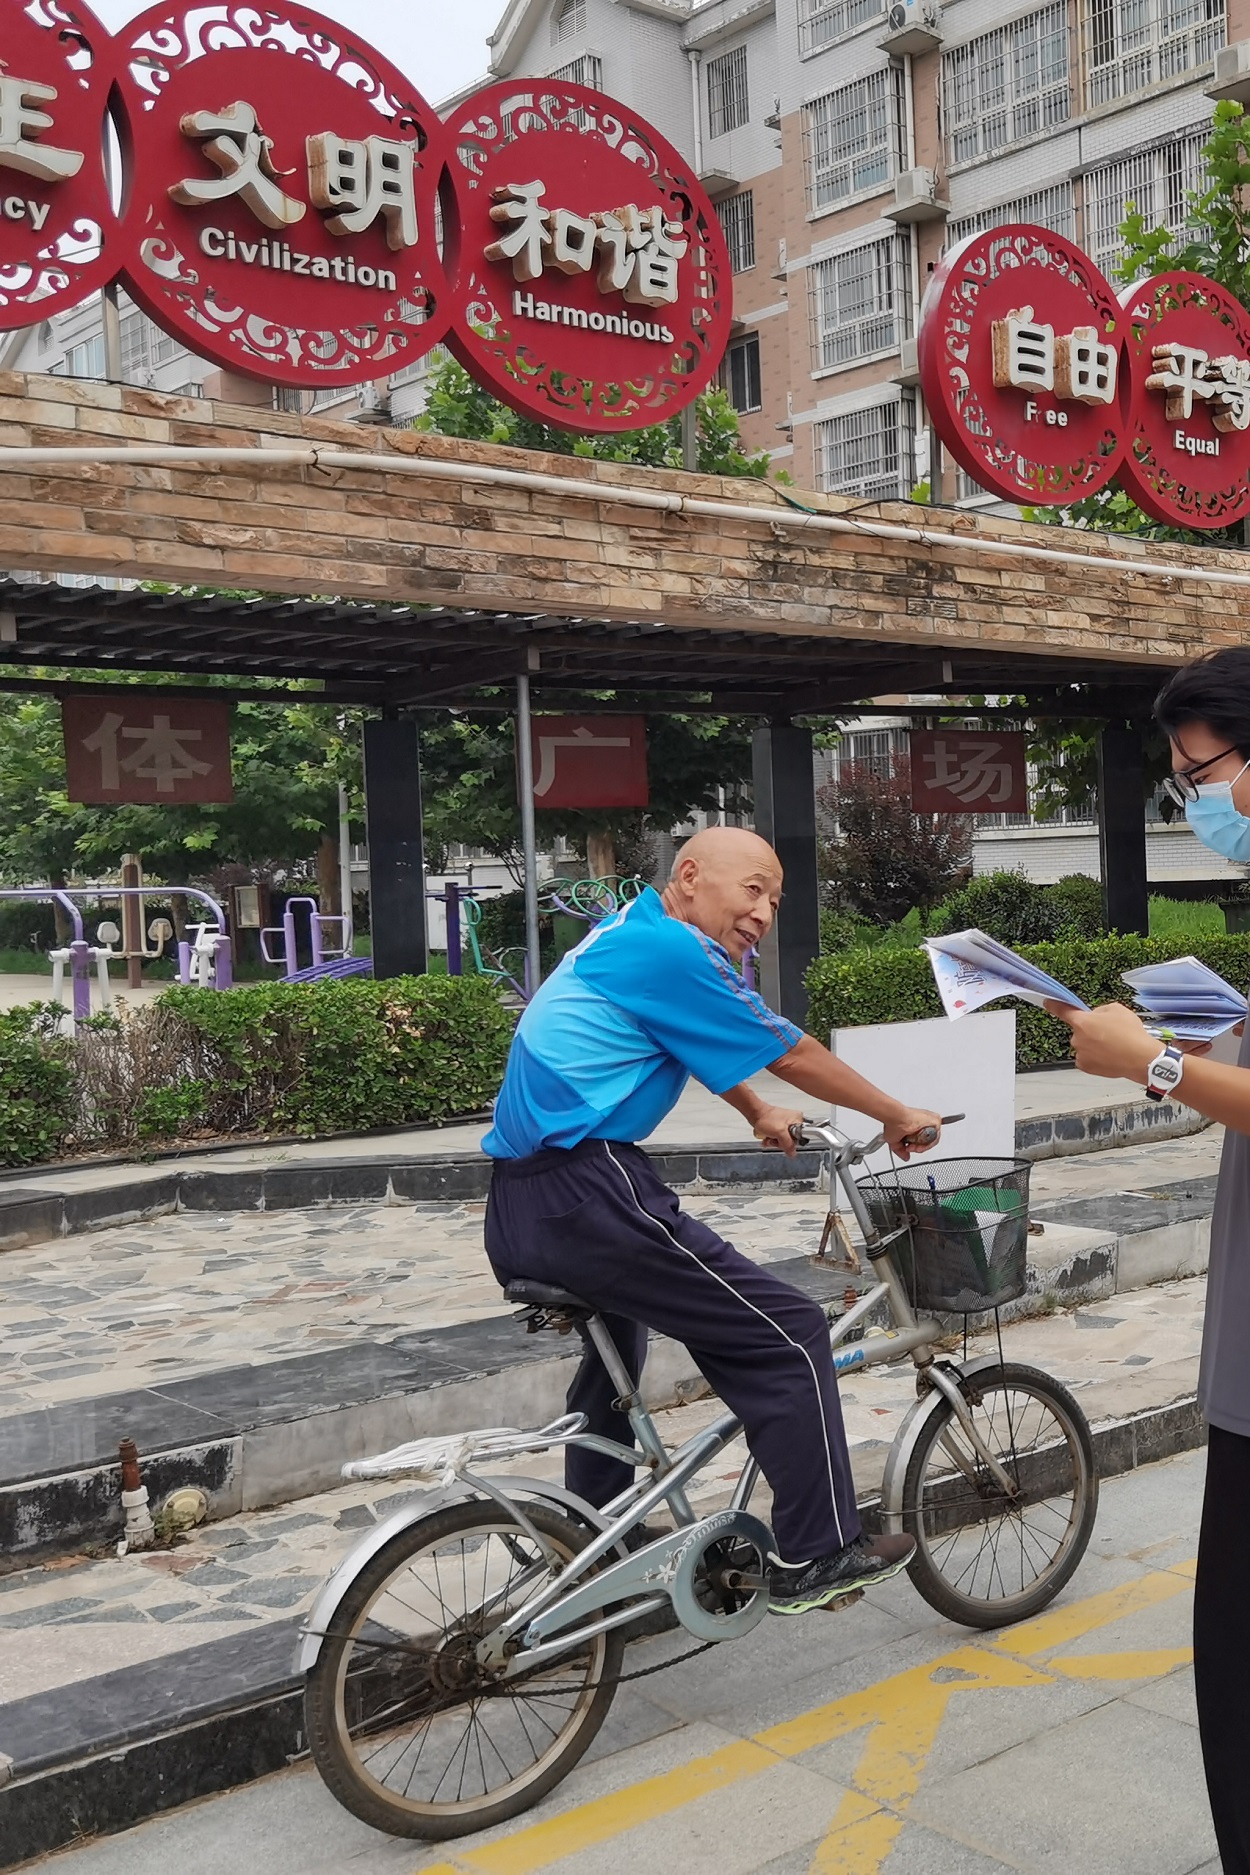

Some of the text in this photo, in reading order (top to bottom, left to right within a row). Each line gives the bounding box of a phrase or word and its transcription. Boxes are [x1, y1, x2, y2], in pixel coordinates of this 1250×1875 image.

[168, 100, 418, 252] 文明
[0, 195, 51, 232] cy
[484, 179, 688, 307] 和谐
[200, 227, 397, 292] Civilization
[513, 290, 676, 345] Harmonious
[991, 305, 1118, 406] 自由
[1025, 400, 1068, 427] Fee
[1173, 429, 1220, 456] Equal
[82, 711, 213, 793] 体
[533, 726, 631, 797] 广
[922, 741, 1013, 804] 场
